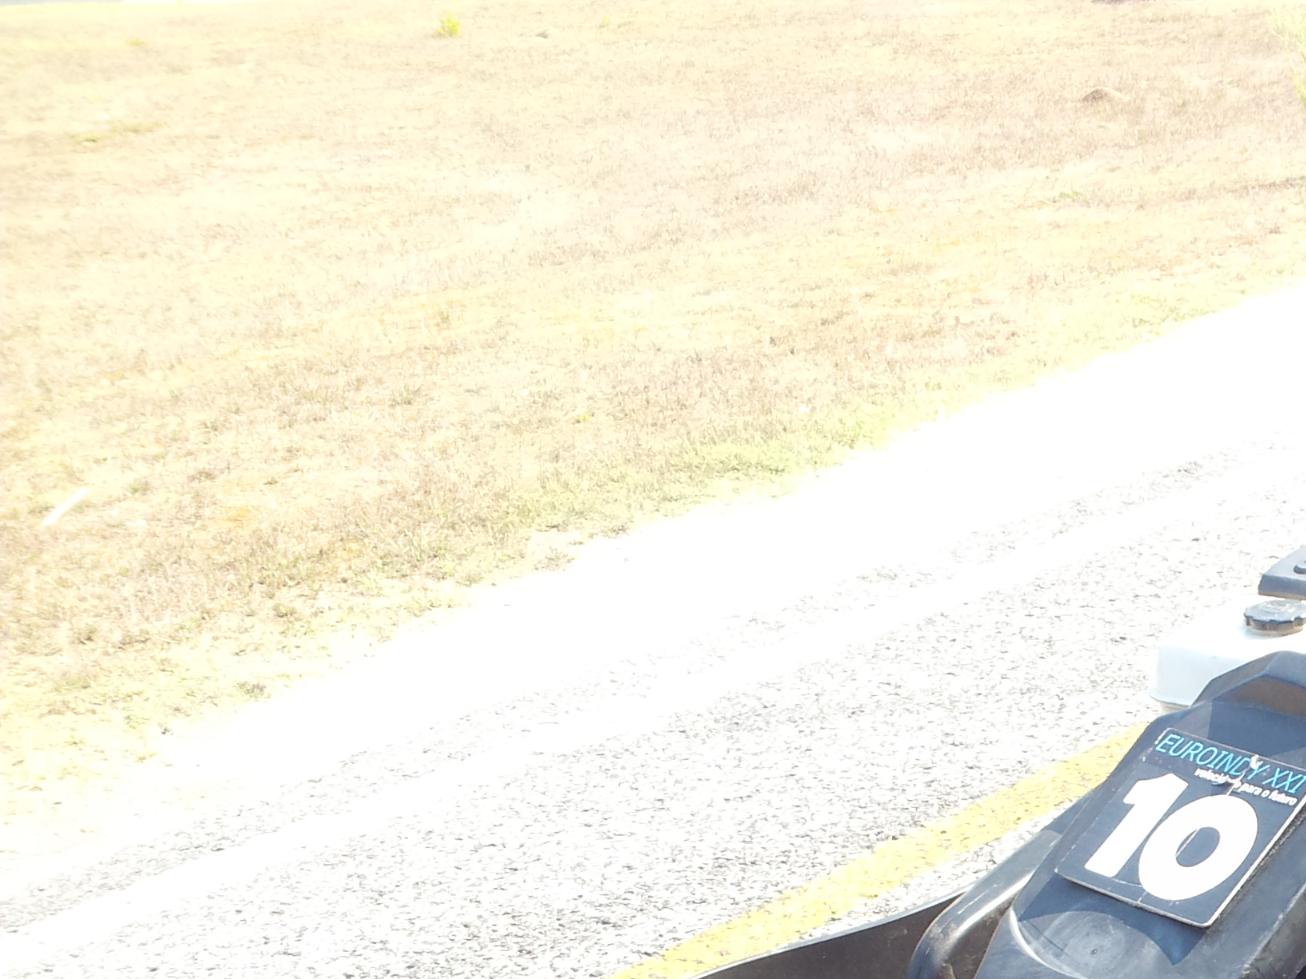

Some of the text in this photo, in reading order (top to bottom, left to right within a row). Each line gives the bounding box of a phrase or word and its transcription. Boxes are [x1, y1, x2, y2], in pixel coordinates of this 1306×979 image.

[1155, 733, 1271, 780] EUROINDY
[1238, 783, 1262, 797] para
[1261, 789, 1270, 798] o
[1268, 789, 1297, 806] futuro
[1084, 773, 1258, 901] 10
